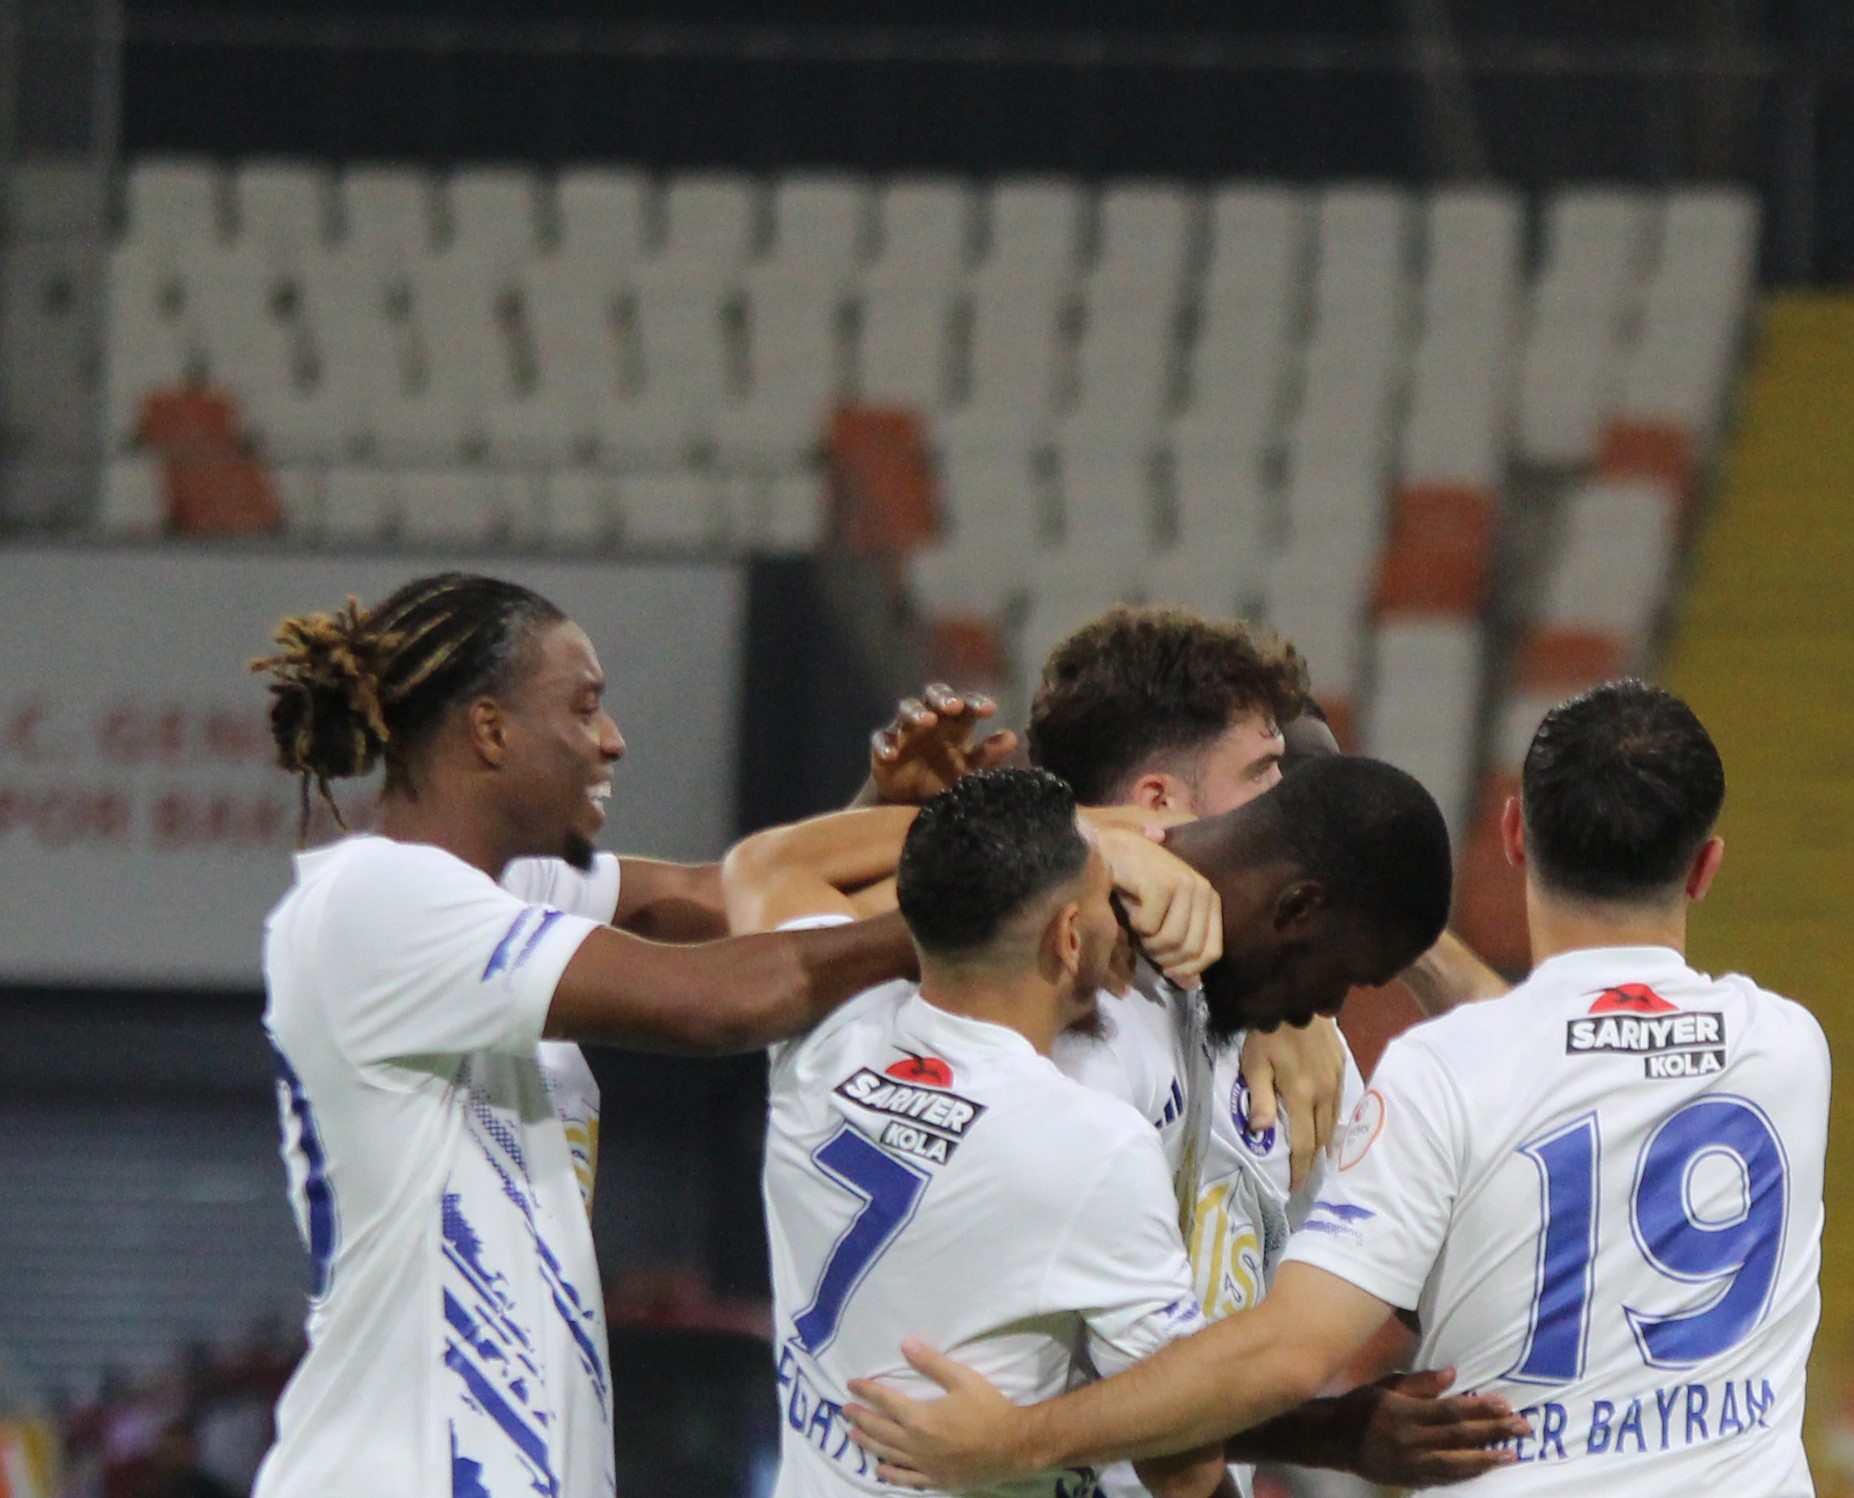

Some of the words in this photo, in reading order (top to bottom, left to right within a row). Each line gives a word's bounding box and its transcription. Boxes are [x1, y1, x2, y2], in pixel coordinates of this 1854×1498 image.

[1571, 1013, 1720, 1050] SARIYER
[1650, 1052, 1721, 1078] KOLA
[844, 1072, 975, 1134] SARIYER
[884, 1123, 948, 1163] KOLA
[793, 1120, 934, 1360] 7
[1502, 1092, 1791, 1386] 19
[1508, 1402, 1569, 1463] ER
